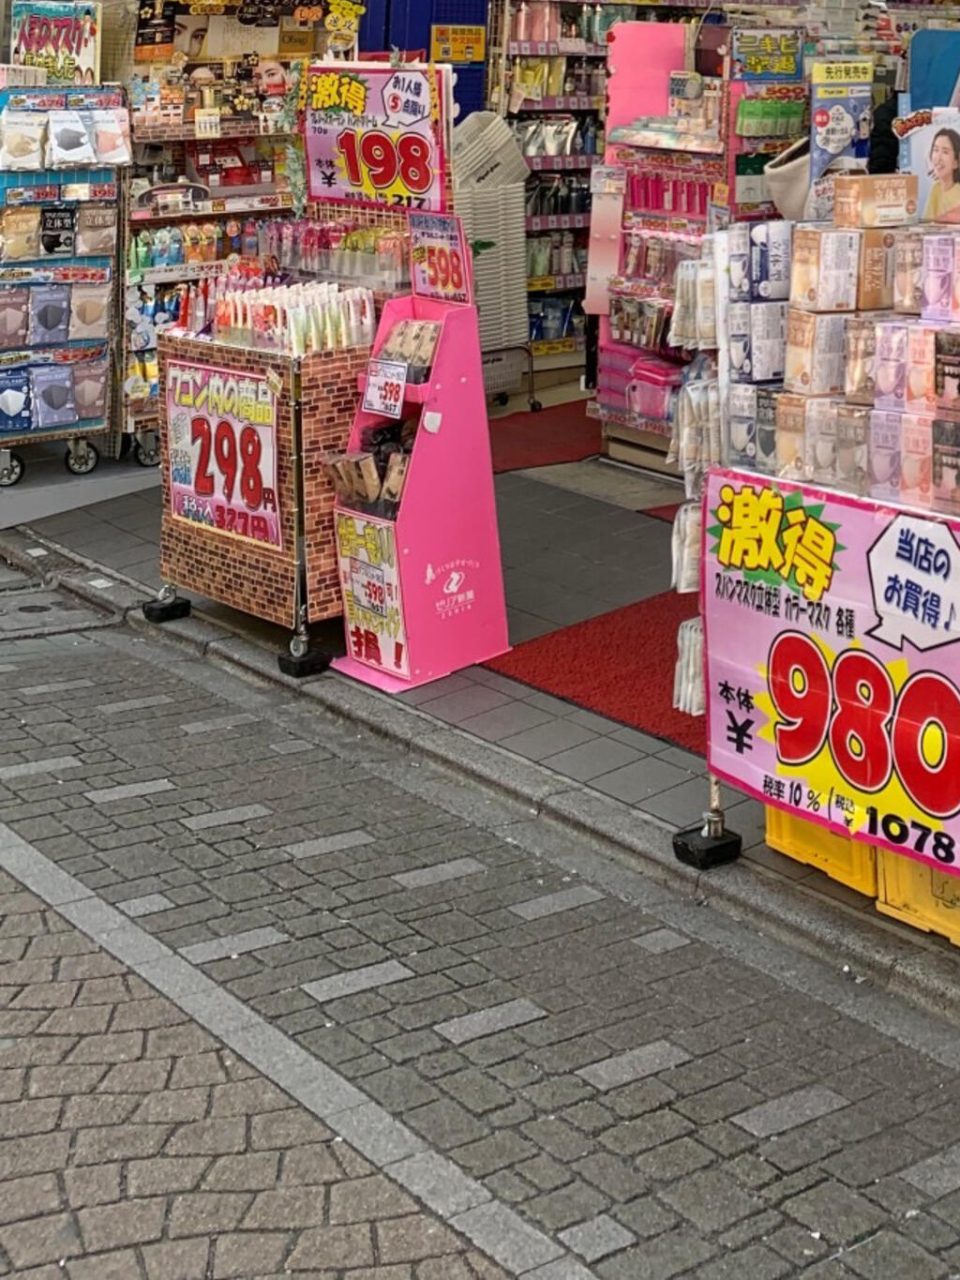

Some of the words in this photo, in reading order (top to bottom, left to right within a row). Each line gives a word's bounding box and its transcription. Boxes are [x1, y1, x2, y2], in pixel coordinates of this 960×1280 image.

[736, 33, 800, 55] ニキビ
[310, 71, 367, 116] 激得
[389, 94, 401, 111] 5
[321, 170, 337, 188] ¥
[337, 128, 434, 194] 198
[426, 245, 464, 290] 598
[168, 367, 274, 427] ワゴン内の商品
[383, 381, 401, 403] 598
[190, 416, 263, 513] 298
[262, 487, 277, 513] 円
[716, 484, 837, 601] 激得
[894, 526, 953, 581] 当店の
[783, 594, 832, 631] カラーマスク
[835, 607, 856, 640] 各種
[717, 680, 755, 713] 本体
[725, 708, 755, 755] ¥
[761, 773, 785, 800] 税率
[788, 784, 803, 807] 10
[806, 791, 821, 813] %
